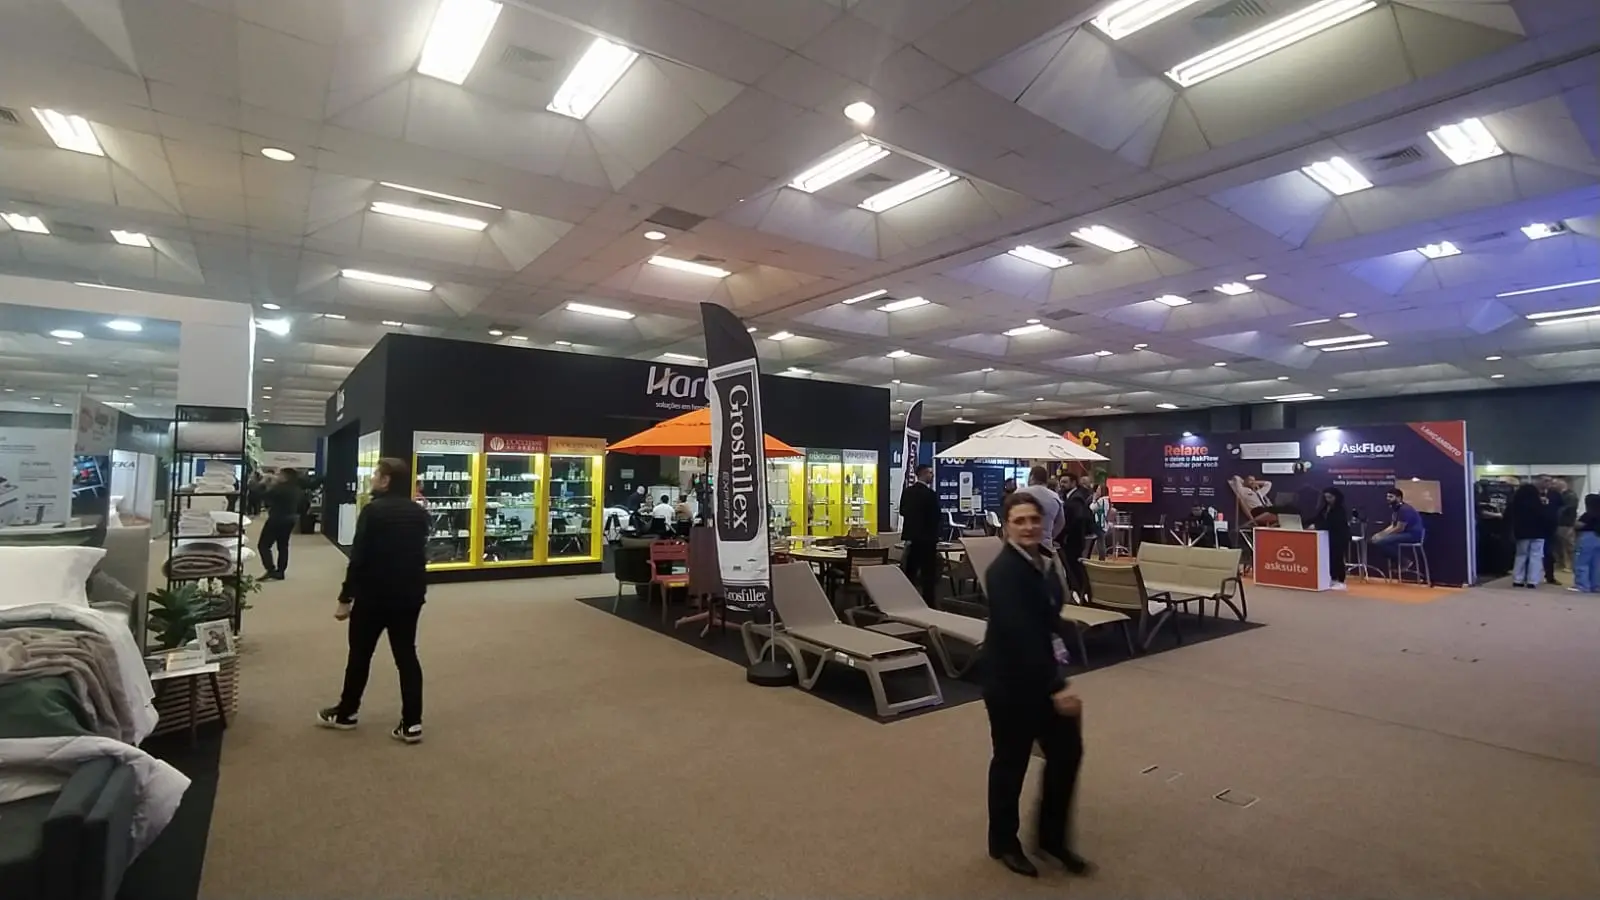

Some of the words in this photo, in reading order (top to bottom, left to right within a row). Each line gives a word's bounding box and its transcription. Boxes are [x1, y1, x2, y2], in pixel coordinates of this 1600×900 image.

[421, 438, 448, 446] COSTA
[1164, 444, 1209, 456] Relaxe
[1340, 443, 1396, 454] AskFlow
[728, 384, 753, 530] Grosfillex
[1264, 561, 1309, 574] asksuite
